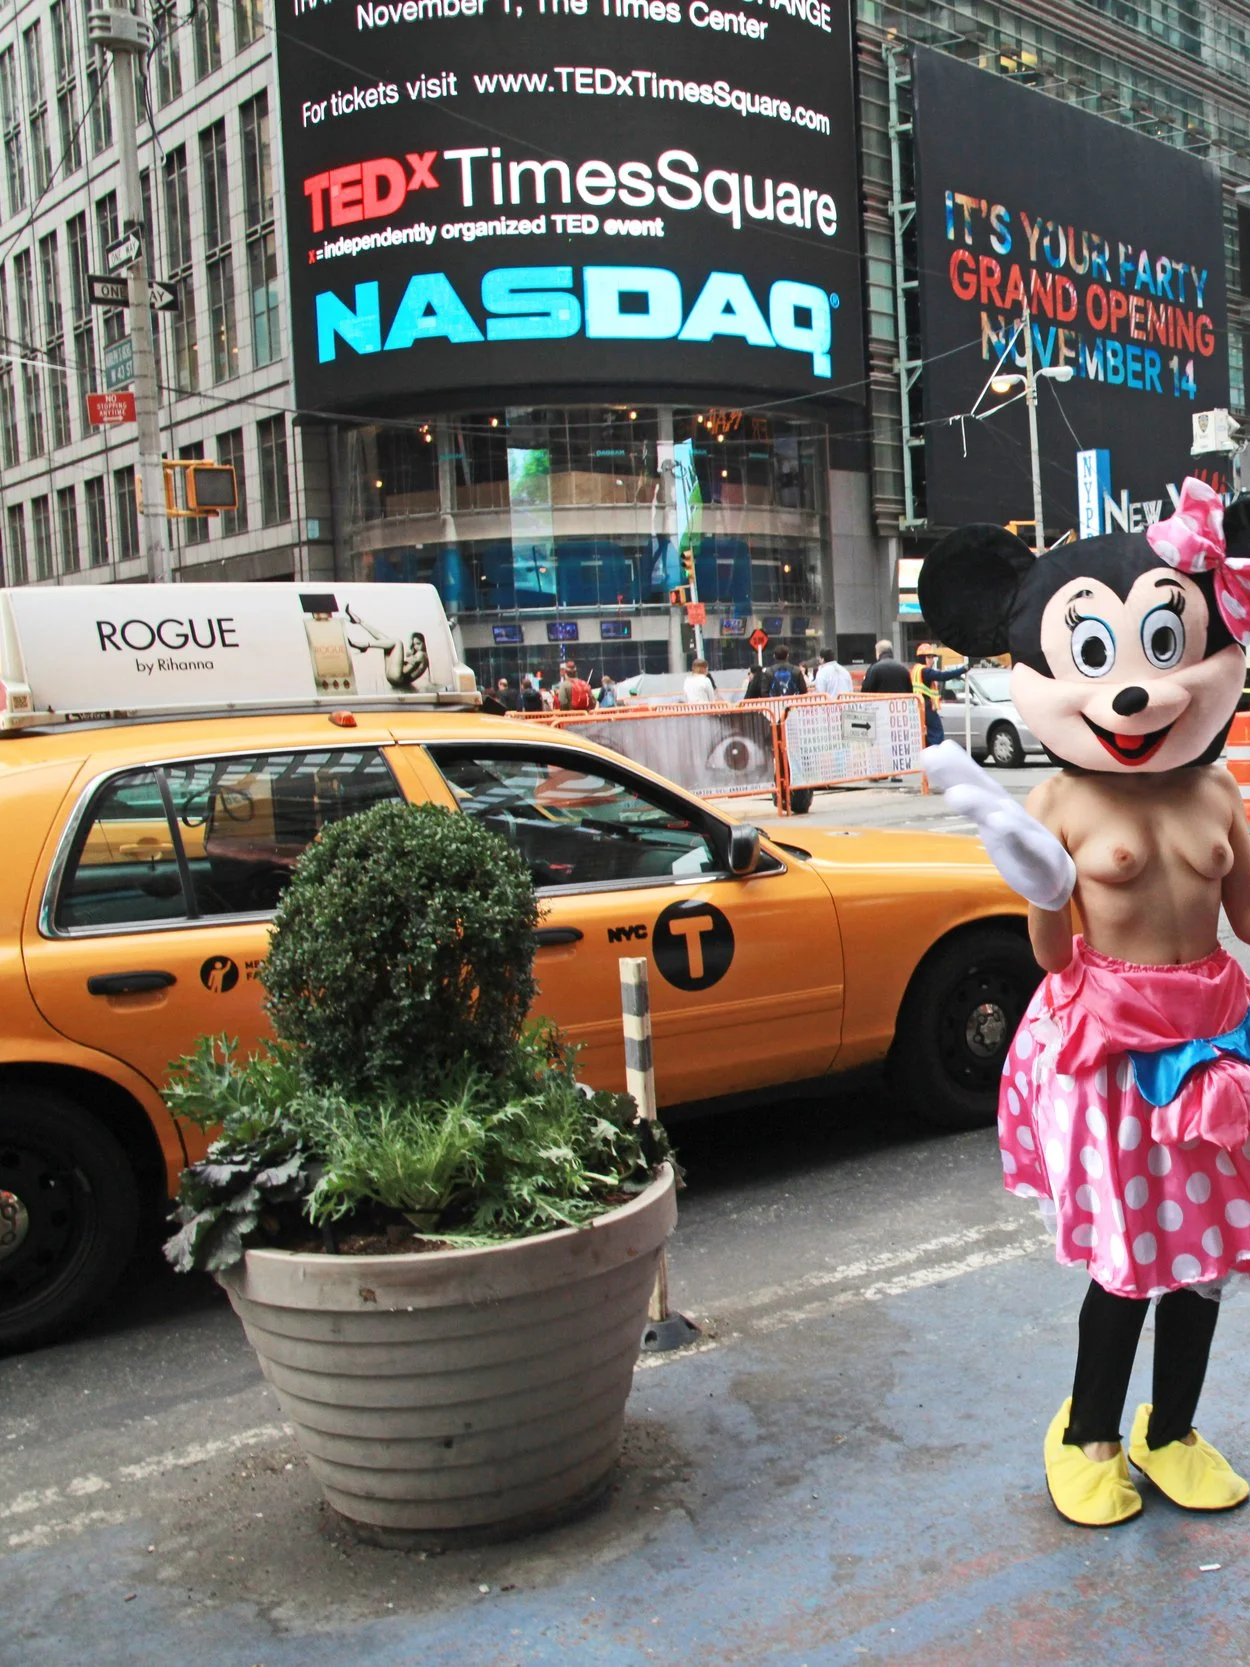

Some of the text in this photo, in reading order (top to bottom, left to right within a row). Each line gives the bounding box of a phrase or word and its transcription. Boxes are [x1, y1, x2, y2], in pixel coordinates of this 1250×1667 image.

[356, 0, 484, 31] November
[601, 0, 682, 24] Times
[689, 0, 768, 40] Center
[302, 67, 831, 135] For tickets visit www.TEDxTimesSquare.com
[443, 147, 838, 236] TimesSquare
[441, 215, 546, 242] organized
[551, 214, 600, 234] TED
[603, 217, 664, 237] event
[945, 190, 1208, 309] IT'S YOUR PARTY
[101, 283, 129, 299] ONE
[950, 249, 1215, 357] GRAND OPENING
[315, 266, 832, 378] NASDAQ
[981, 311, 1197, 400] NOVEMBER 14
[1083, 456, 1094, 538] NYP
[95, 618, 240, 652] ROGUE
[135, 658, 214, 674] by Rihanna
[889, 701, 908, 713] OLD
[890, 714, 909, 727] OLD
[890, 730, 910, 742] NEW
[891, 744, 911, 757] NEW
[892, 758, 912, 771] NEW
[607, 914, 714, 979] NYC T
